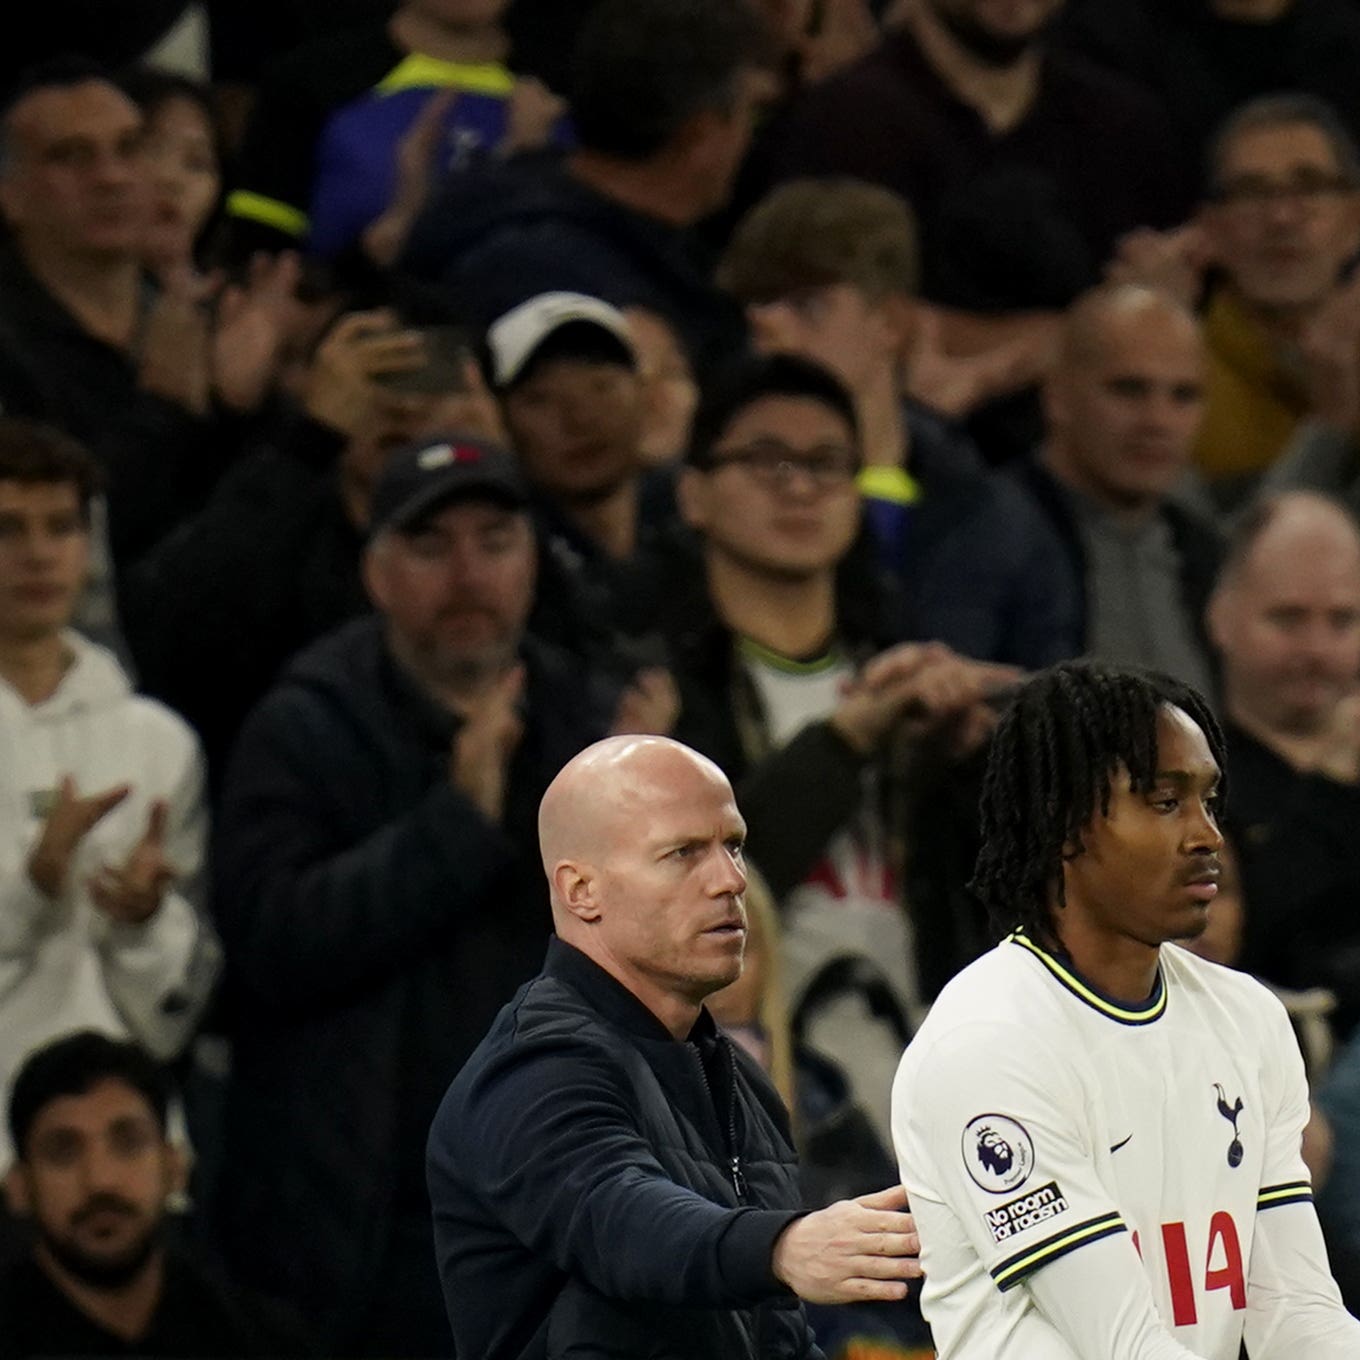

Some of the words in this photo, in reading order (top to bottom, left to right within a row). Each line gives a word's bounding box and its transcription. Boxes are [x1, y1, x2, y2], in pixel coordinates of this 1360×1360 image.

[1008, 1188, 1056, 1219] room
[1012, 1198, 1068, 1233] racism
[1132, 1211, 1246, 1327] IA
